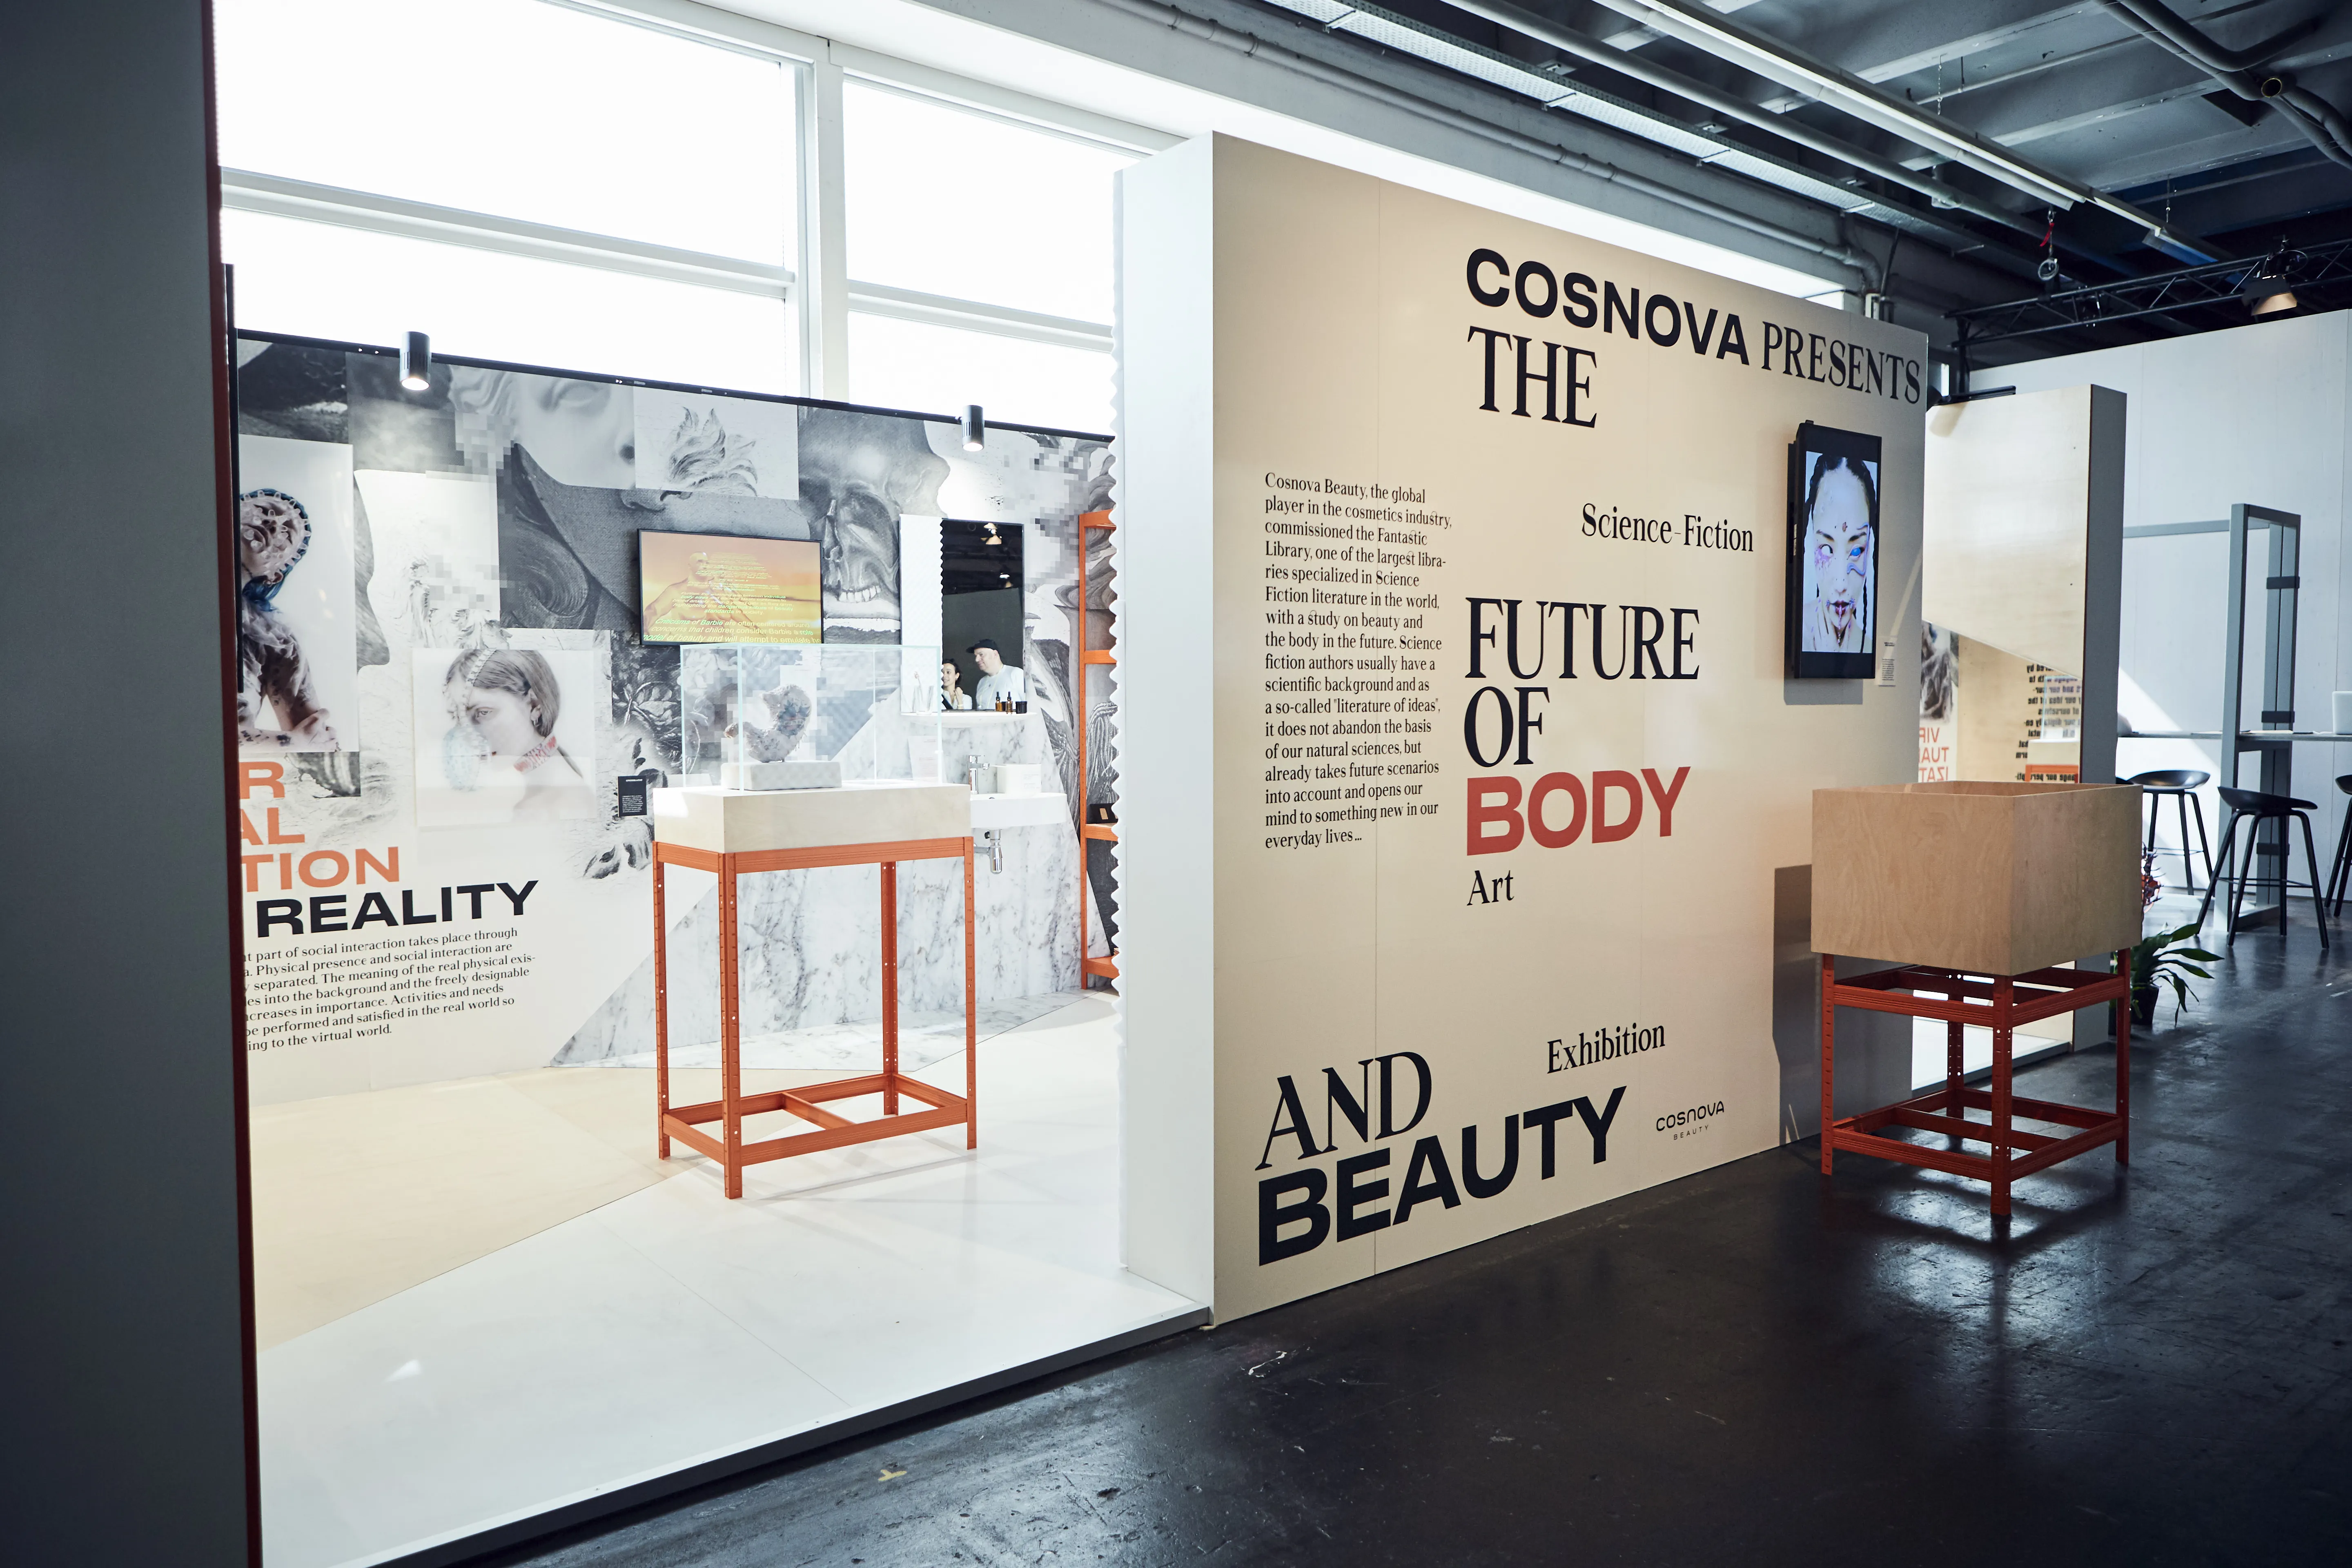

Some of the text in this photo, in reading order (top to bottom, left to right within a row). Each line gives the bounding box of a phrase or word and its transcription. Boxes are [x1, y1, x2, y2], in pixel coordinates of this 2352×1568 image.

[1467, 249, 1920, 404] COSNOVA PRESENTS
[1468, 326, 1597, 428] THE
[1265, 472, 1425, 503] Cosnova Beauty, the global
[1265, 495, 1451, 529] player in the cosmetics industry,
[1582, 503, 1753, 552] Science-Fiction
[1265, 521, 1427, 546] commissioned the Fantastic
[1266, 541, 1446, 568] Library, one of the largest libra-
[1265, 564, 1419, 587] ries specialized in Science
[1266, 586, 1439, 610] Fiction literature in the world,
[1265, 609, 1422, 631] with a study on beauty and
[1265, 631, 1442, 650] the body in the future. Science
[1465, 597, 1699, 679] FUTURE
[1265, 653, 1435, 673] fiction authors usually have a
[1265, 676, 1429, 695] scientific background and as
[1464, 686, 1549, 767] OF
[1467, 767, 1690, 855] BODY
[1467, 871, 1514, 906] Art
[257, 880, 538, 938] REALITY
[256, 951, 281, 963] part
[286, 947, 299, 958] of
[302, 944, 337, 956] social
[341, 939, 405, 953] interaction
[409, 936, 439, 946] takes
[442, 933, 471, 945] place
[474, 927, 517, 940] through
[256, 961, 309, 976] Physical
[313, 958, 366, 972] presence
[370, 953, 390, 964] and
[394, 949, 427, 962] social
[431, 945, 492, 958] interaction
[254, 954, 535, 991] separated. The meaning of the real physical exis-
[265, 995, 289, 1004] into
[293, 991, 312, 1001] the
[316, 982, 386, 998] background
[390, 979, 410, 991] and
[414, 978, 431, 988] the
[435, 974, 468, 986] freely
[472, 967, 529, 981] designable
[263, 1017, 329, 1036] performed
[332, 1014, 353, 1026] and
[357, 1008, 404, 1023] satisfied
[408, 1008, 418, 1017] in
[422, 1005, 439, 1015] the
[443, 1001, 464, 1013] real
[468, 997, 499, 1009] world
[301, 1005, 312, 1015] in
[316, 999, 387, 1014] importance.
[391, 991, 446, 1004] Activities
[450, 987, 469, 998] and
[472, 983, 503, 995] needs
[272, 1039, 284, 1047] to
[288, 1035, 307, 1046] the
[312, 1029, 352, 1042] virtual
[356, 1024, 392, 1037] world.
[1548, 1023, 1665, 1074] Exhibition
[1255, 1052, 1432, 1171] AND
[1674, 1125, 1708, 1140] BEAUTY
[1259, 1086, 1626, 1266] BEAUTY
